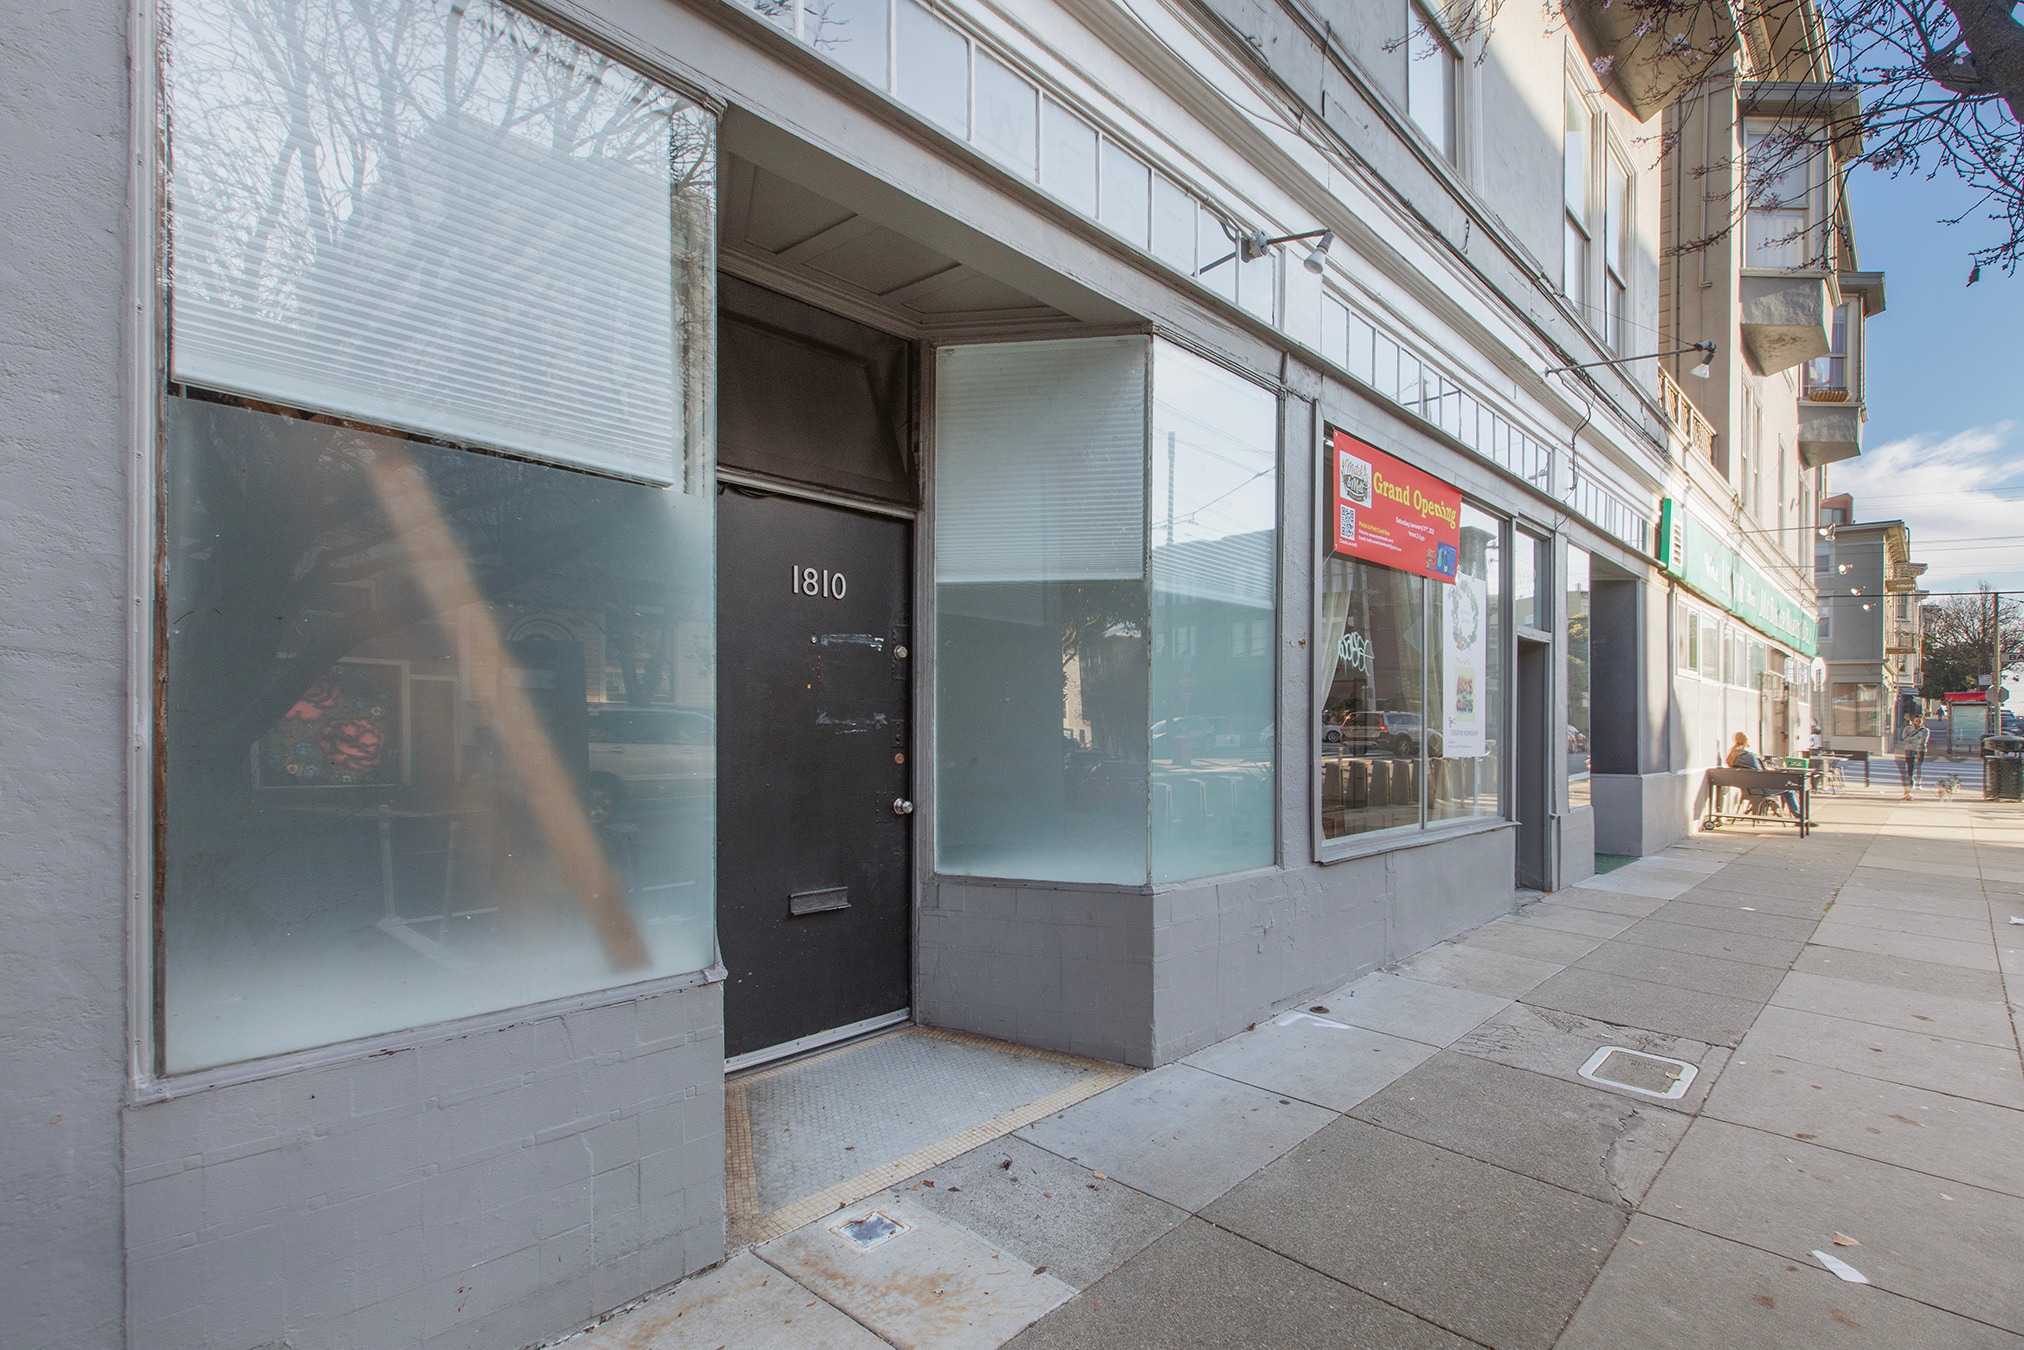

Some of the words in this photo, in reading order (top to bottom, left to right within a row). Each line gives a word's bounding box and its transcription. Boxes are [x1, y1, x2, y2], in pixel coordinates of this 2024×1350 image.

[1373, 471, 1410, 506] Grand
[1413, 489, 1457, 530] Opening
[793, 565, 847, 600] 1810
